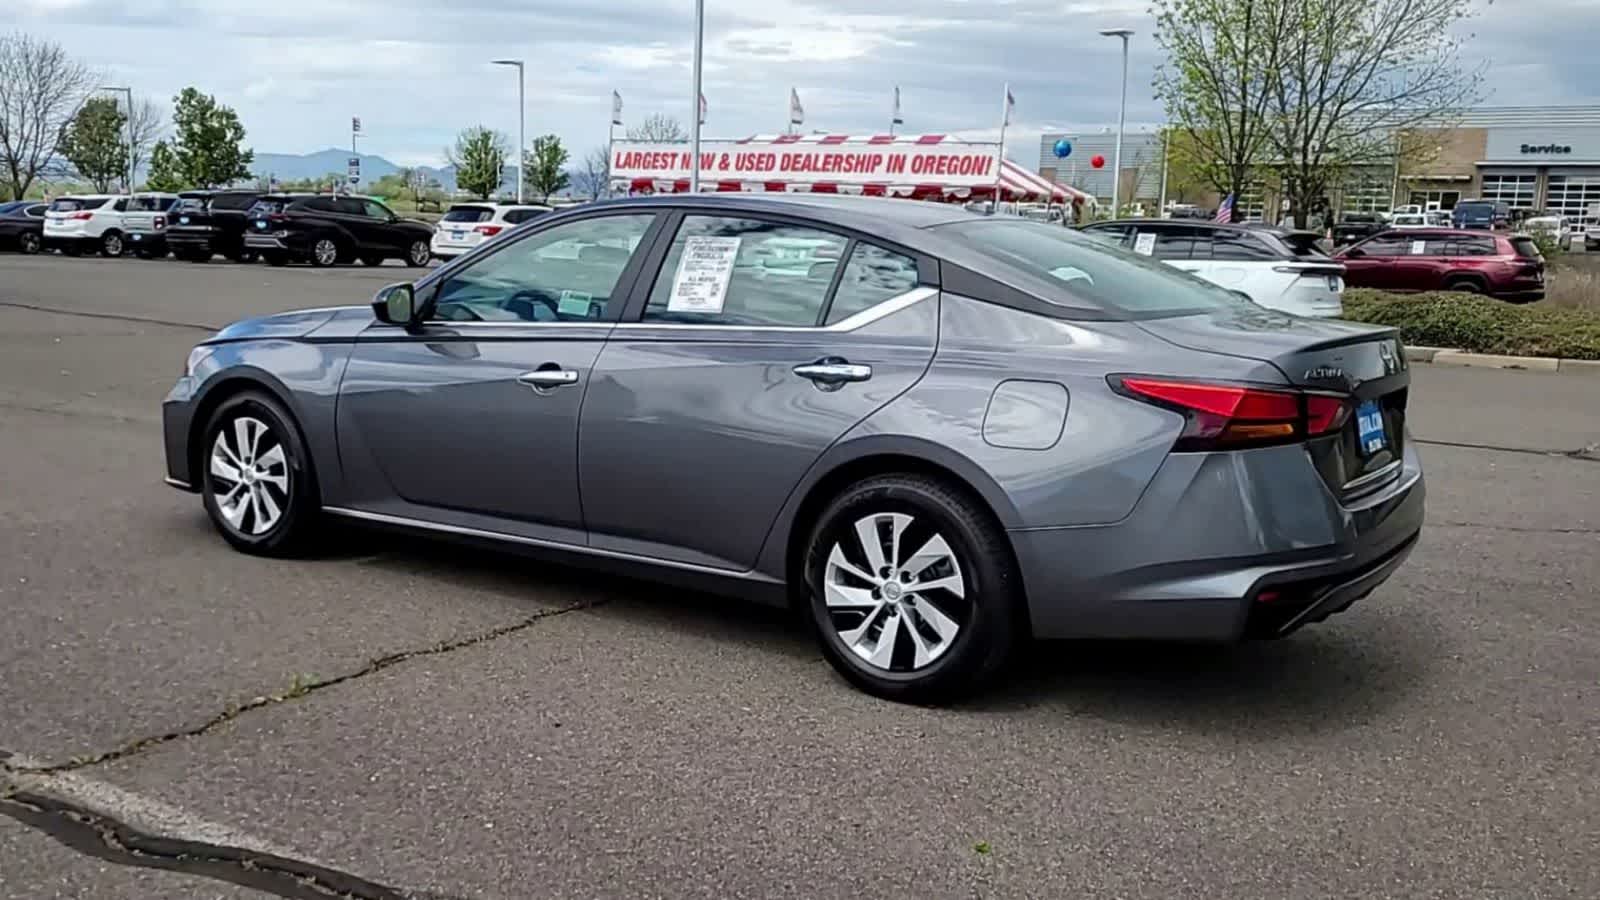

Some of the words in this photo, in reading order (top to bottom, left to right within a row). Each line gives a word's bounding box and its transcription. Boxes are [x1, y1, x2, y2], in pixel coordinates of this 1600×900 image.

[1520, 144, 1571, 154] Service
[615, 152, 678, 170] LARGEST
[681, 152, 716, 170] NW
[718, 153, 730, 171] &
[735, 153, 776, 172] USED
[780, 153, 882, 174] DEALERSHIP
[886, 154, 907, 174] IN
[911, 155, 992, 176] OREGON!
